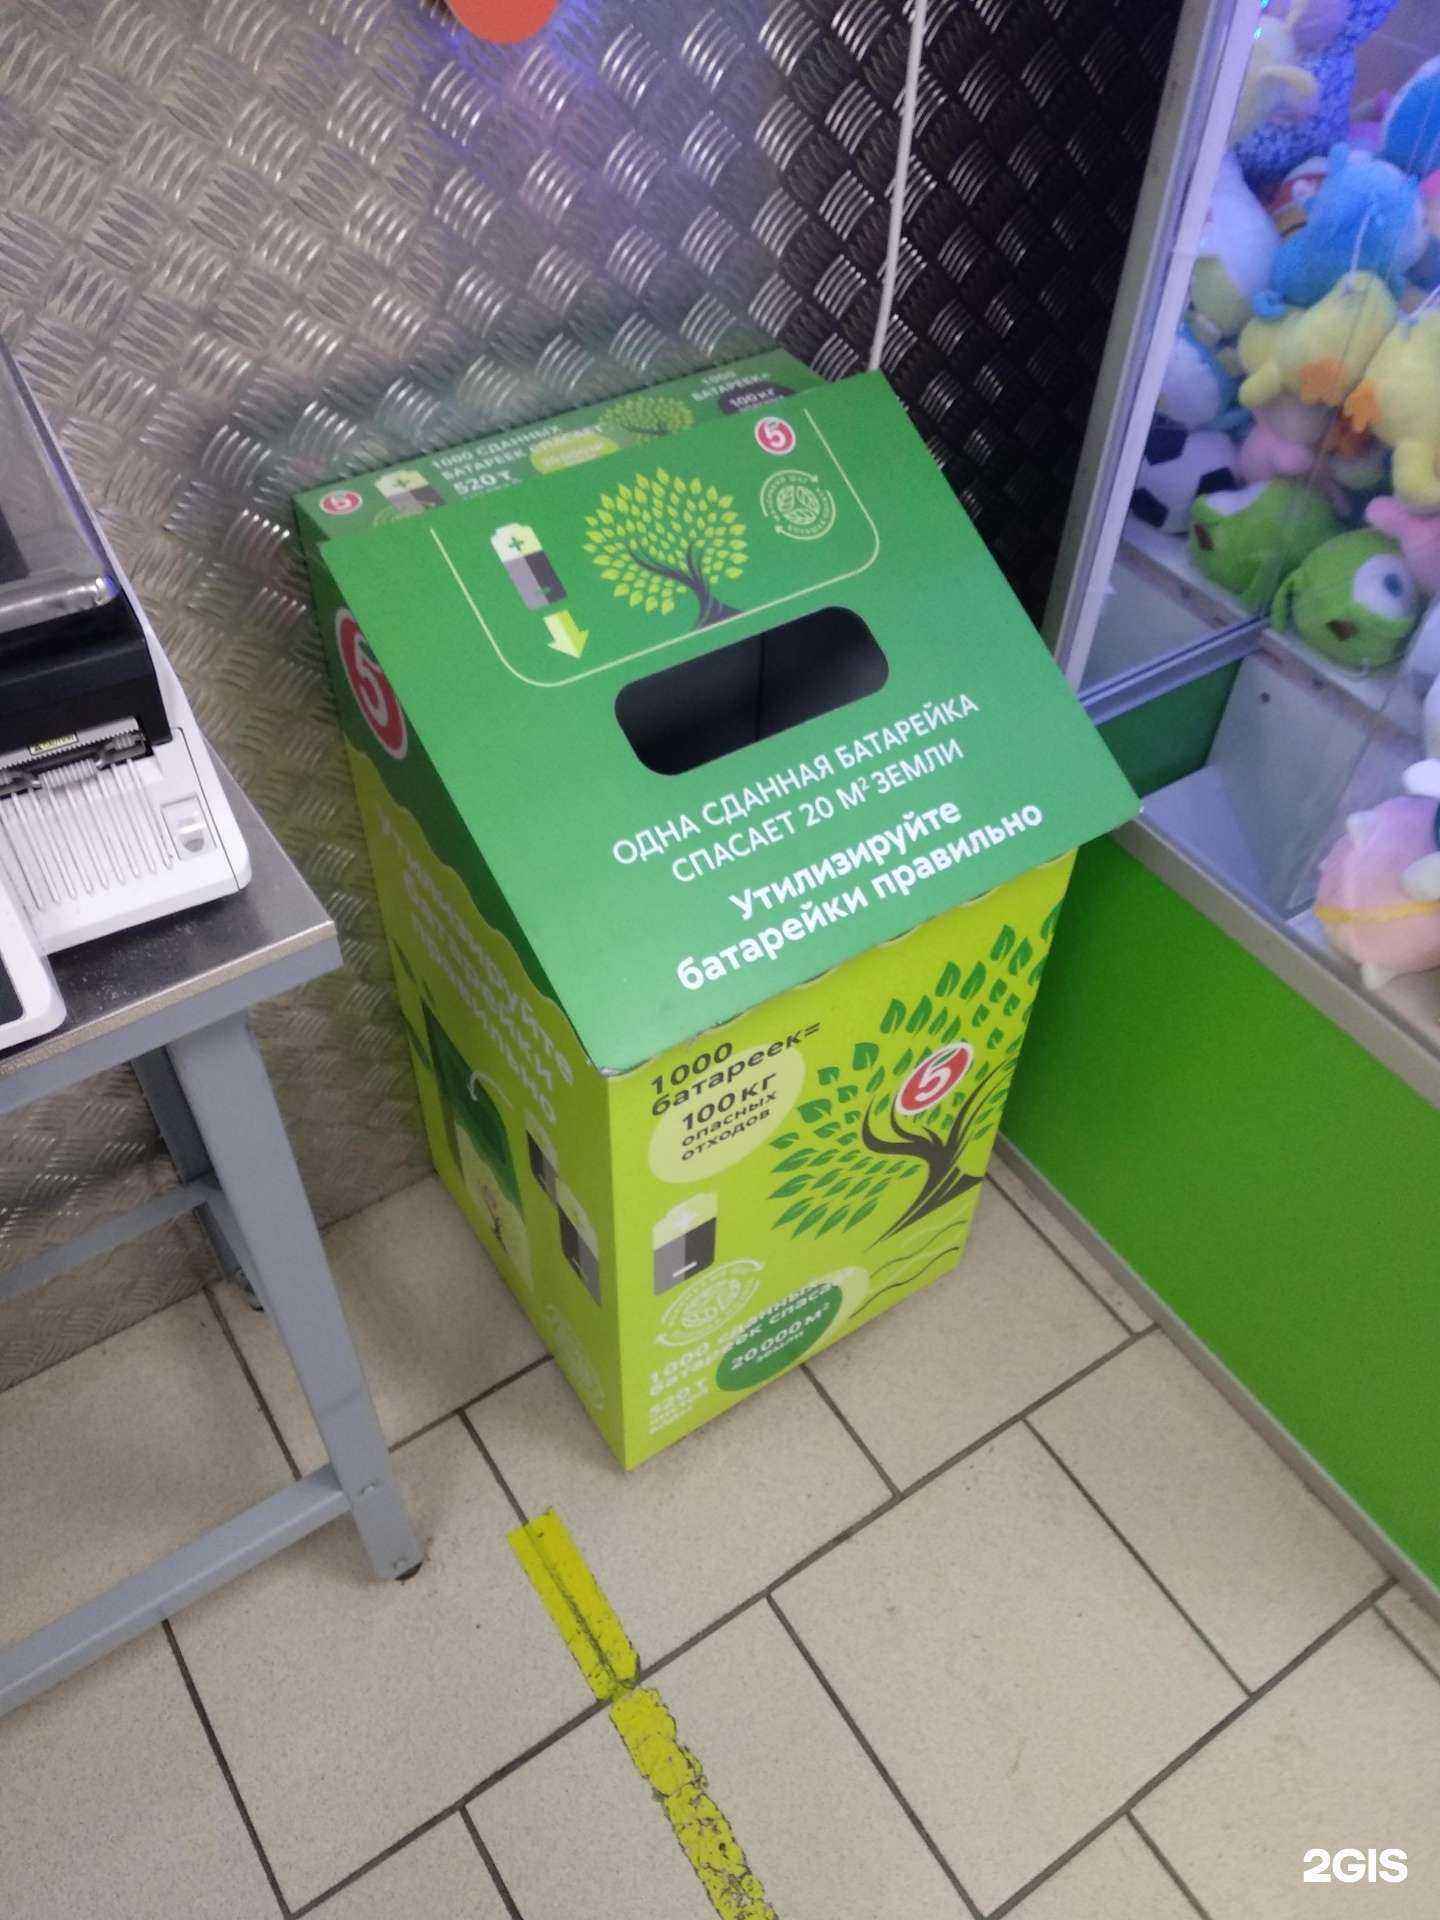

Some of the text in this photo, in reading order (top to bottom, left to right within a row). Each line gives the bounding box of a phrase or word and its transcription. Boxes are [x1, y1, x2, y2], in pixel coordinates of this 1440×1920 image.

[612, 693, 980, 865] ОДНА СДАННАЯ БАТАРЕЙКА
[671, 810, 796, 883] СПАСАЕТ
[798, 795, 834, 828] 20
[870, 738, 965, 795] ЗЕМЛИ
[675, 804, 1044, 991] батарейки правильно
[728, 801, 963, 921] Утилизируйте
[651, 1042, 733, 1095] 1000
[652, 1022, 821, 1117] батареек=
[682, 1072, 777, 1131] 100 кг
[682, 1091, 777, 1147] опасных
[682, 1108, 771, 1161] отходов
[731, 1348, 758, 1371] 20
[761, 1320, 802, 1352] 000
